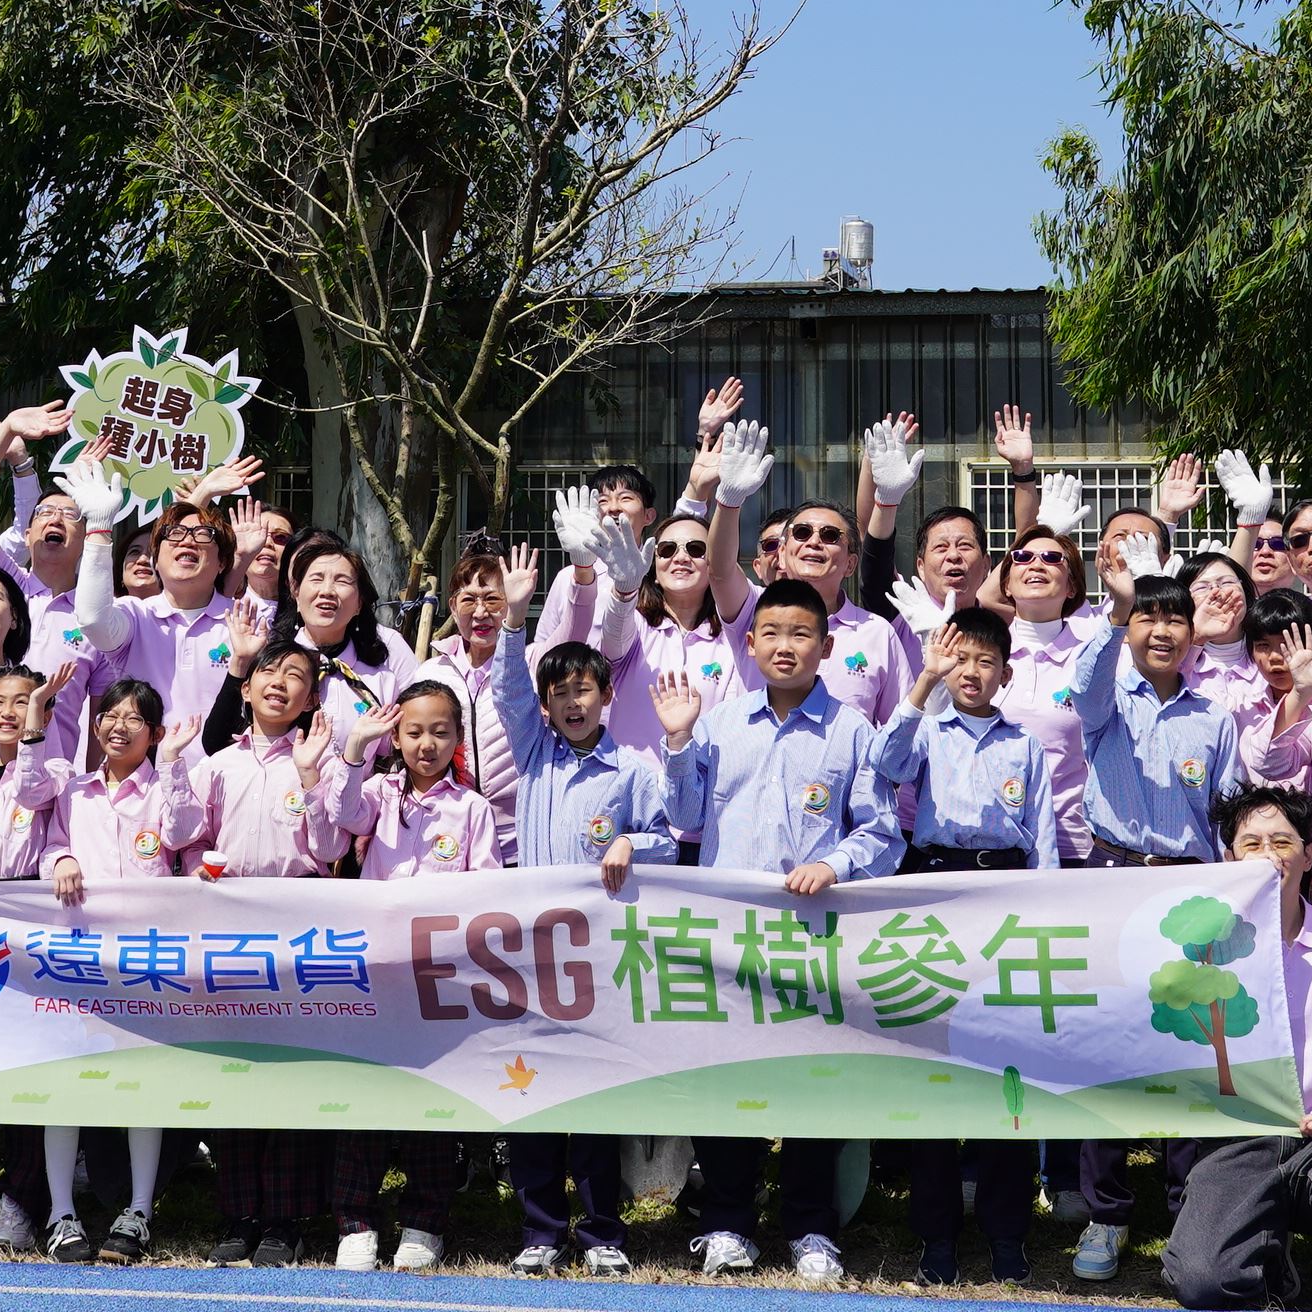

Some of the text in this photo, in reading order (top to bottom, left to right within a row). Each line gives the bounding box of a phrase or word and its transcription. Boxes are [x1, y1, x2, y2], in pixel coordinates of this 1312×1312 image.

[121, 376, 193, 426] 起身
[99, 415, 206, 472] 種小樹
[25, 927, 371, 994] 遠東百貨
[411, 905, 1098, 1033] ESG 植樹參年
[34, 997, 378, 1017] FAR EASTERN DEPARTMENT STORES
